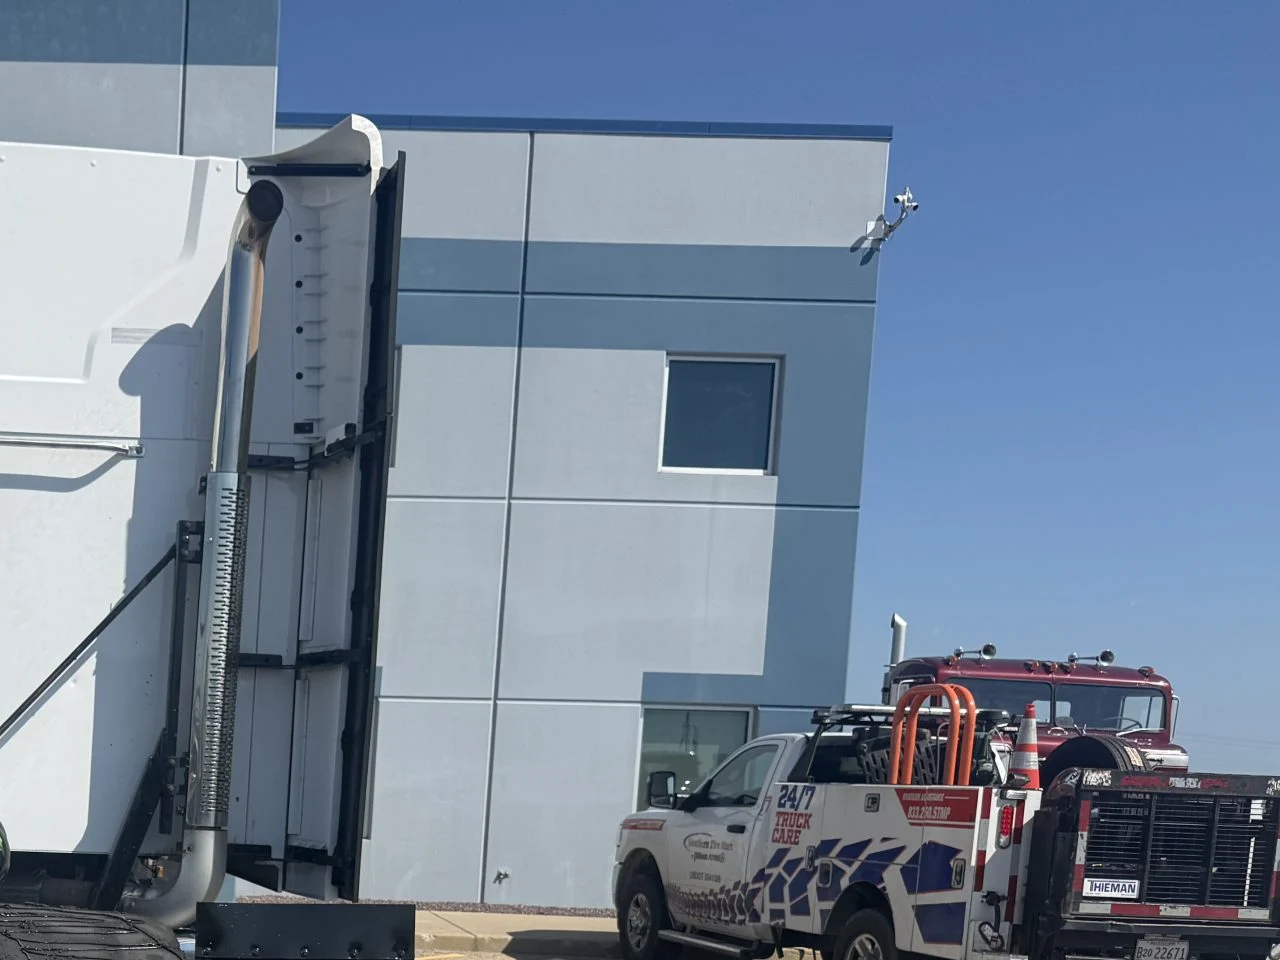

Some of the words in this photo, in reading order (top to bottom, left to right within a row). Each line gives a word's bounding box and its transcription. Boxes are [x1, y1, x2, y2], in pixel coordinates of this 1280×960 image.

[777, 784, 816, 811] 24/7
[775, 811, 813, 829] TRUCK
[771, 828, 802, 846] CARE
[1087, 880, 1137, 893] THIEMAN
[1154, 946, 1185, 960] 22671
